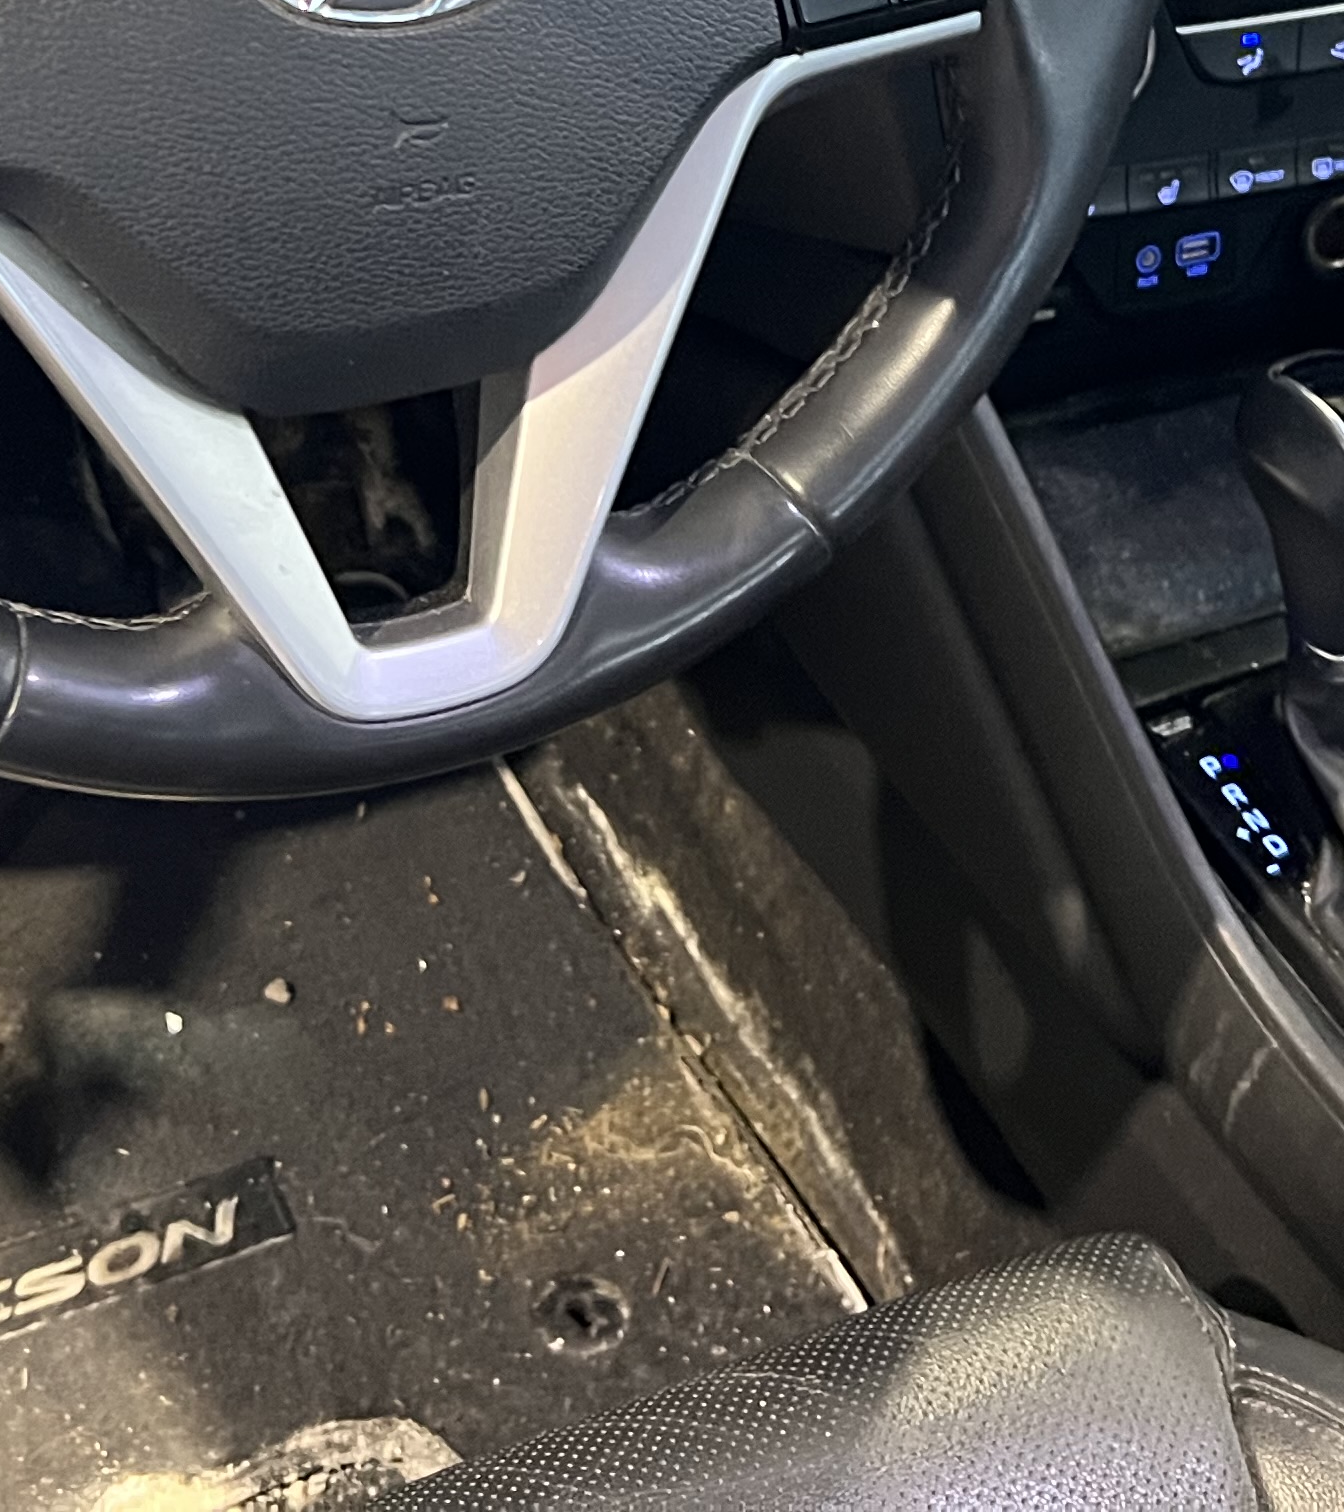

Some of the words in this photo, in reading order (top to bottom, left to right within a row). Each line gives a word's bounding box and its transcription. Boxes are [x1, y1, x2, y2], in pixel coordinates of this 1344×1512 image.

[1198, 754, 1222, 780] P
[1220, 781, 1249, 810] R
[1241, 807, 1271, 834] N
[1261, 833, 1291, 859] D
